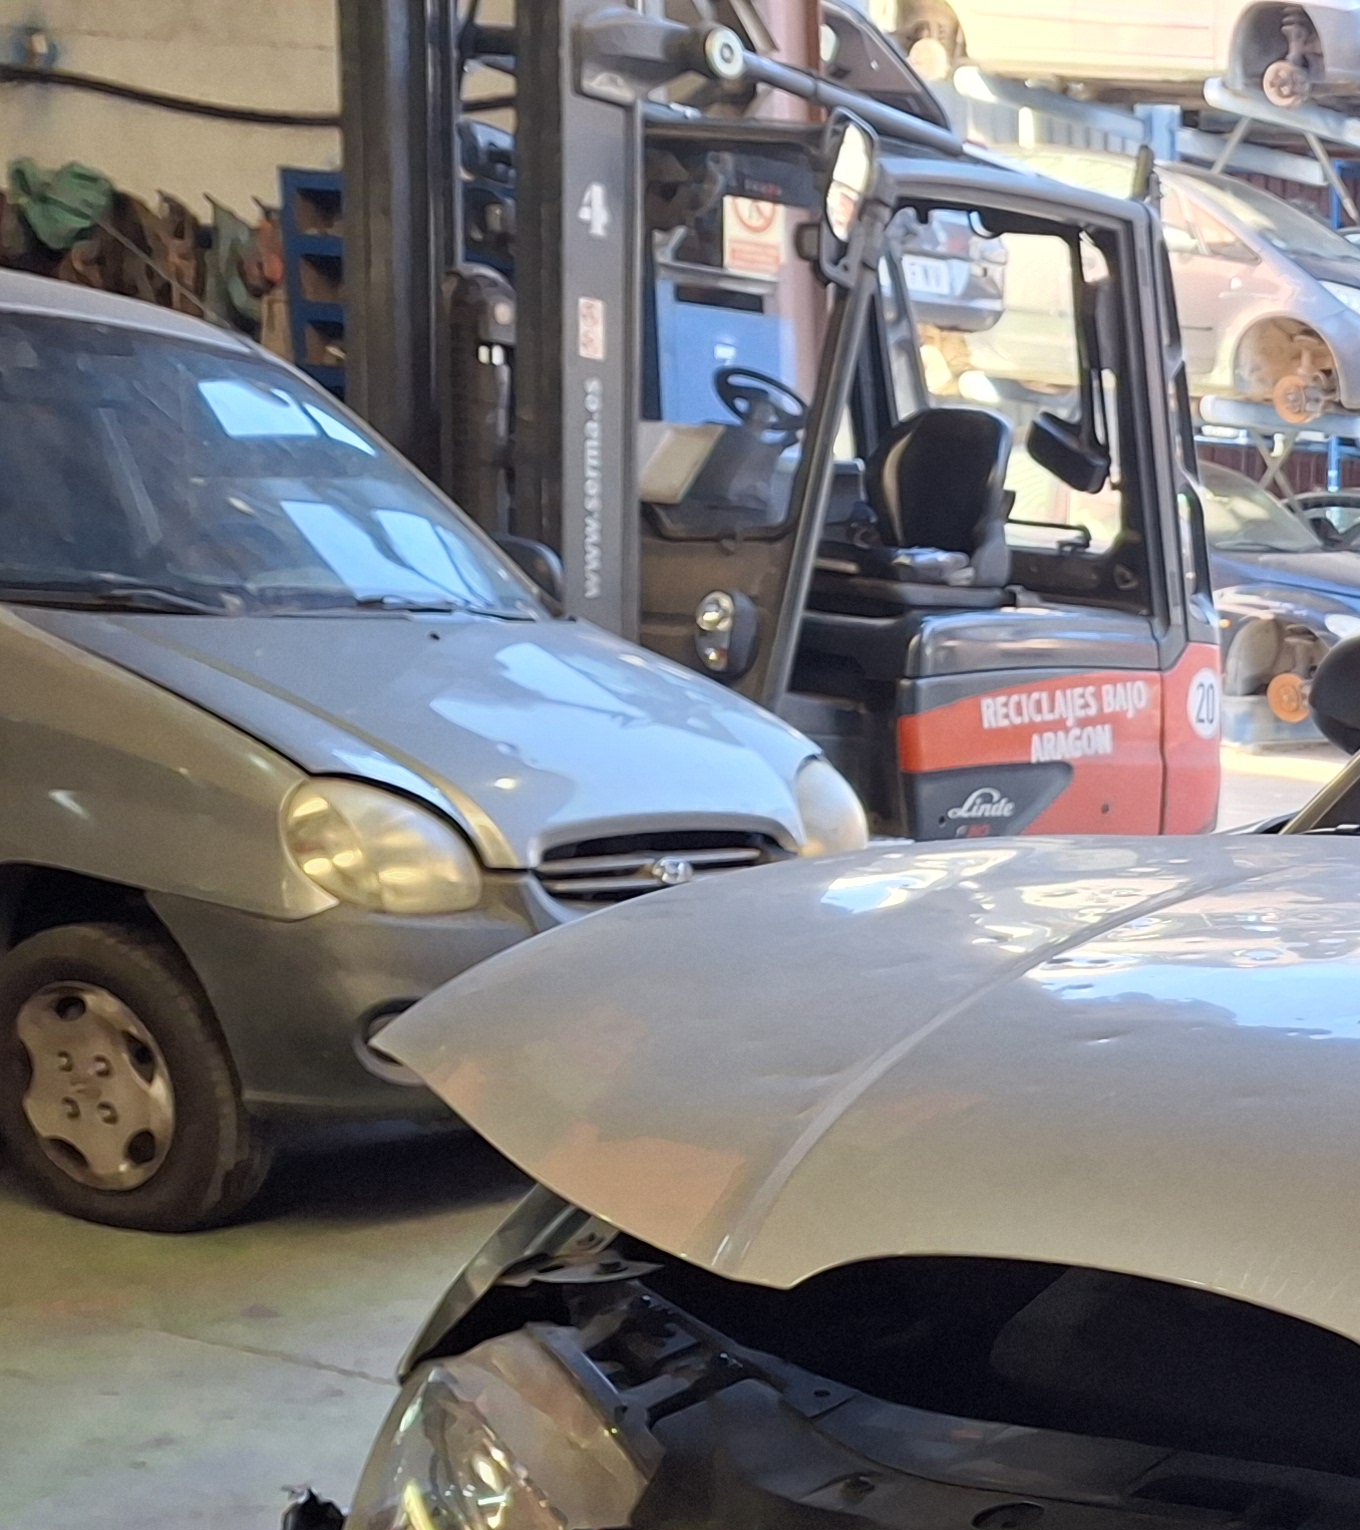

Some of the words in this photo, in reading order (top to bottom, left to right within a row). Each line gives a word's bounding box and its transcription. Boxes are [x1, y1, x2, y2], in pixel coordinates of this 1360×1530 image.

[578, 182, 610, 237] 4
[980, 685, 1098, 729] RECICLAJES
[1102, 680, 1147, 719] BAJO
[1195, 683, 1215, 725] 20
[947, 787, 1015, 819] Linde
